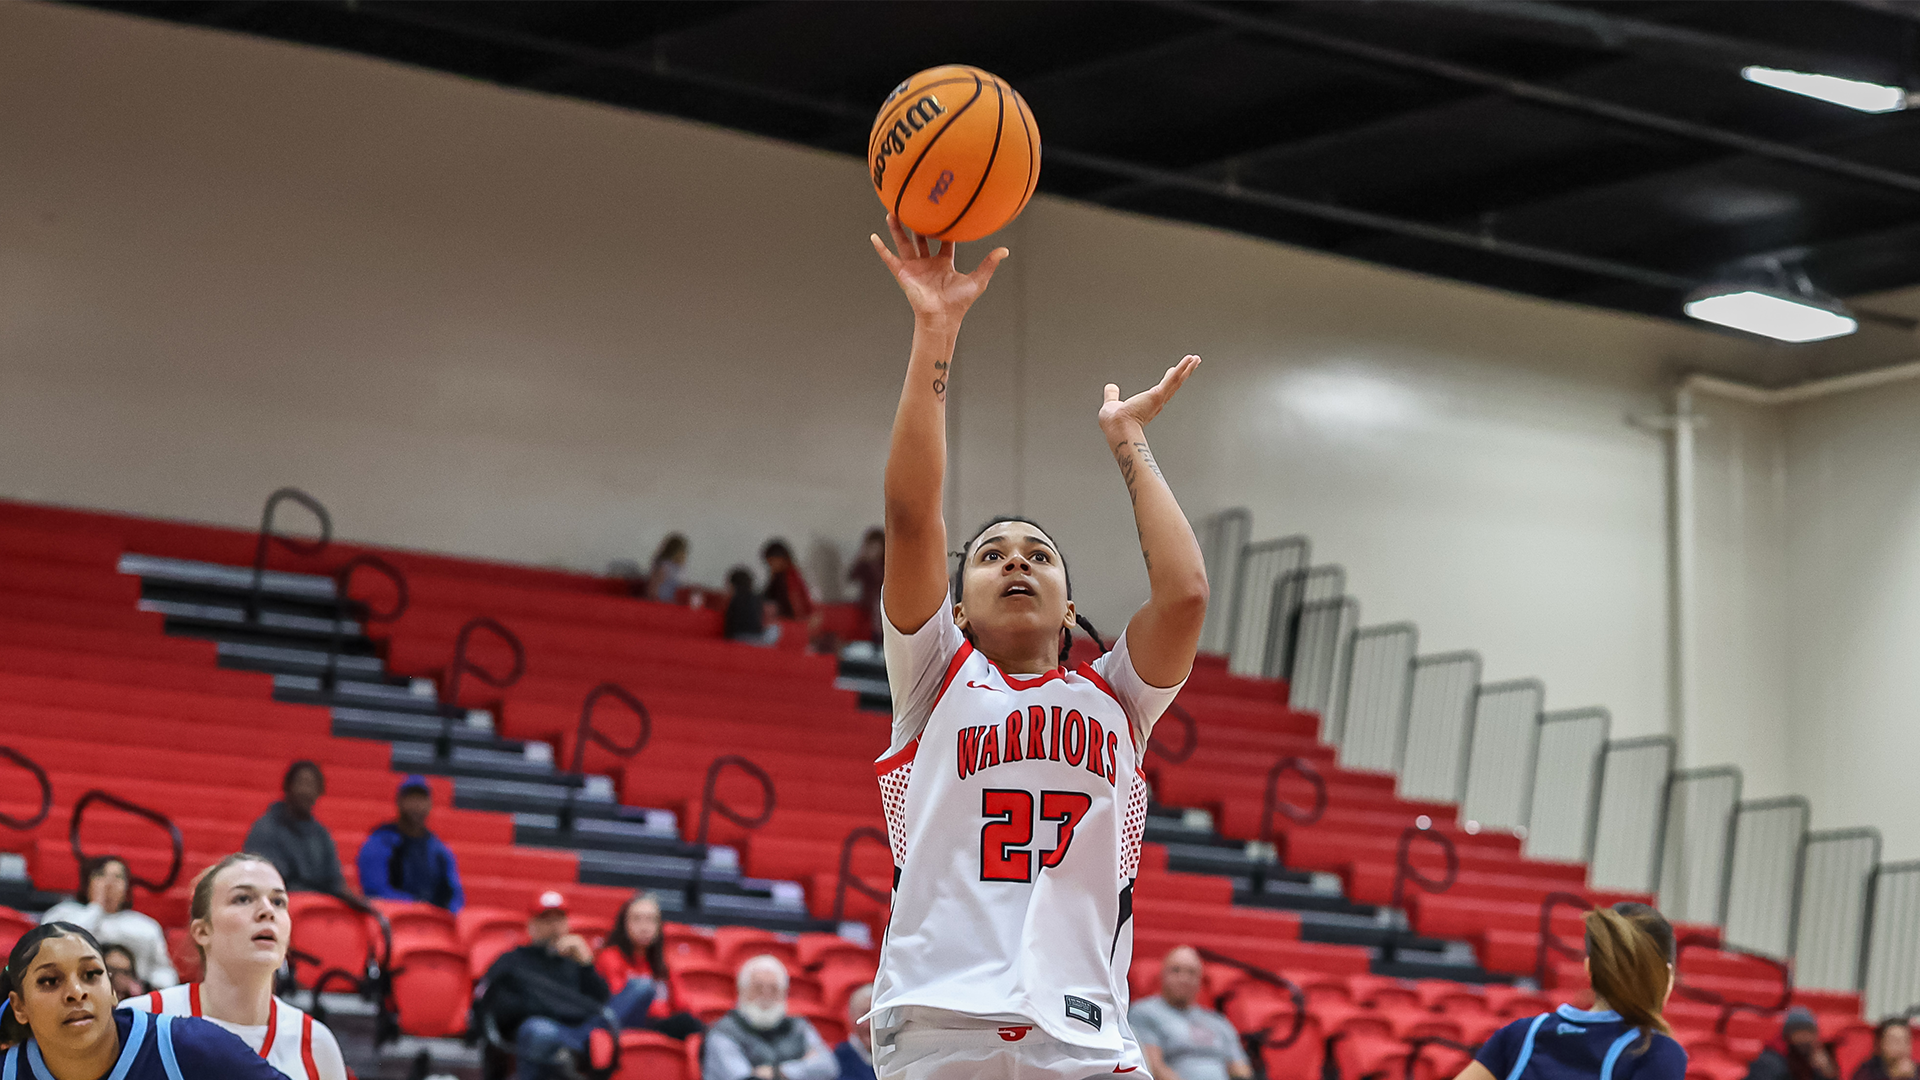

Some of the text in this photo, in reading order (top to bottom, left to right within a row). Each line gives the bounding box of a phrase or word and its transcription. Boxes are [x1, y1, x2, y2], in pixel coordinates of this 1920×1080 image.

[873, 94, 949, 191] Wilson
[957, 705, 1118, 788] WARRIORS
[979, 787, 1093, 884] 23
